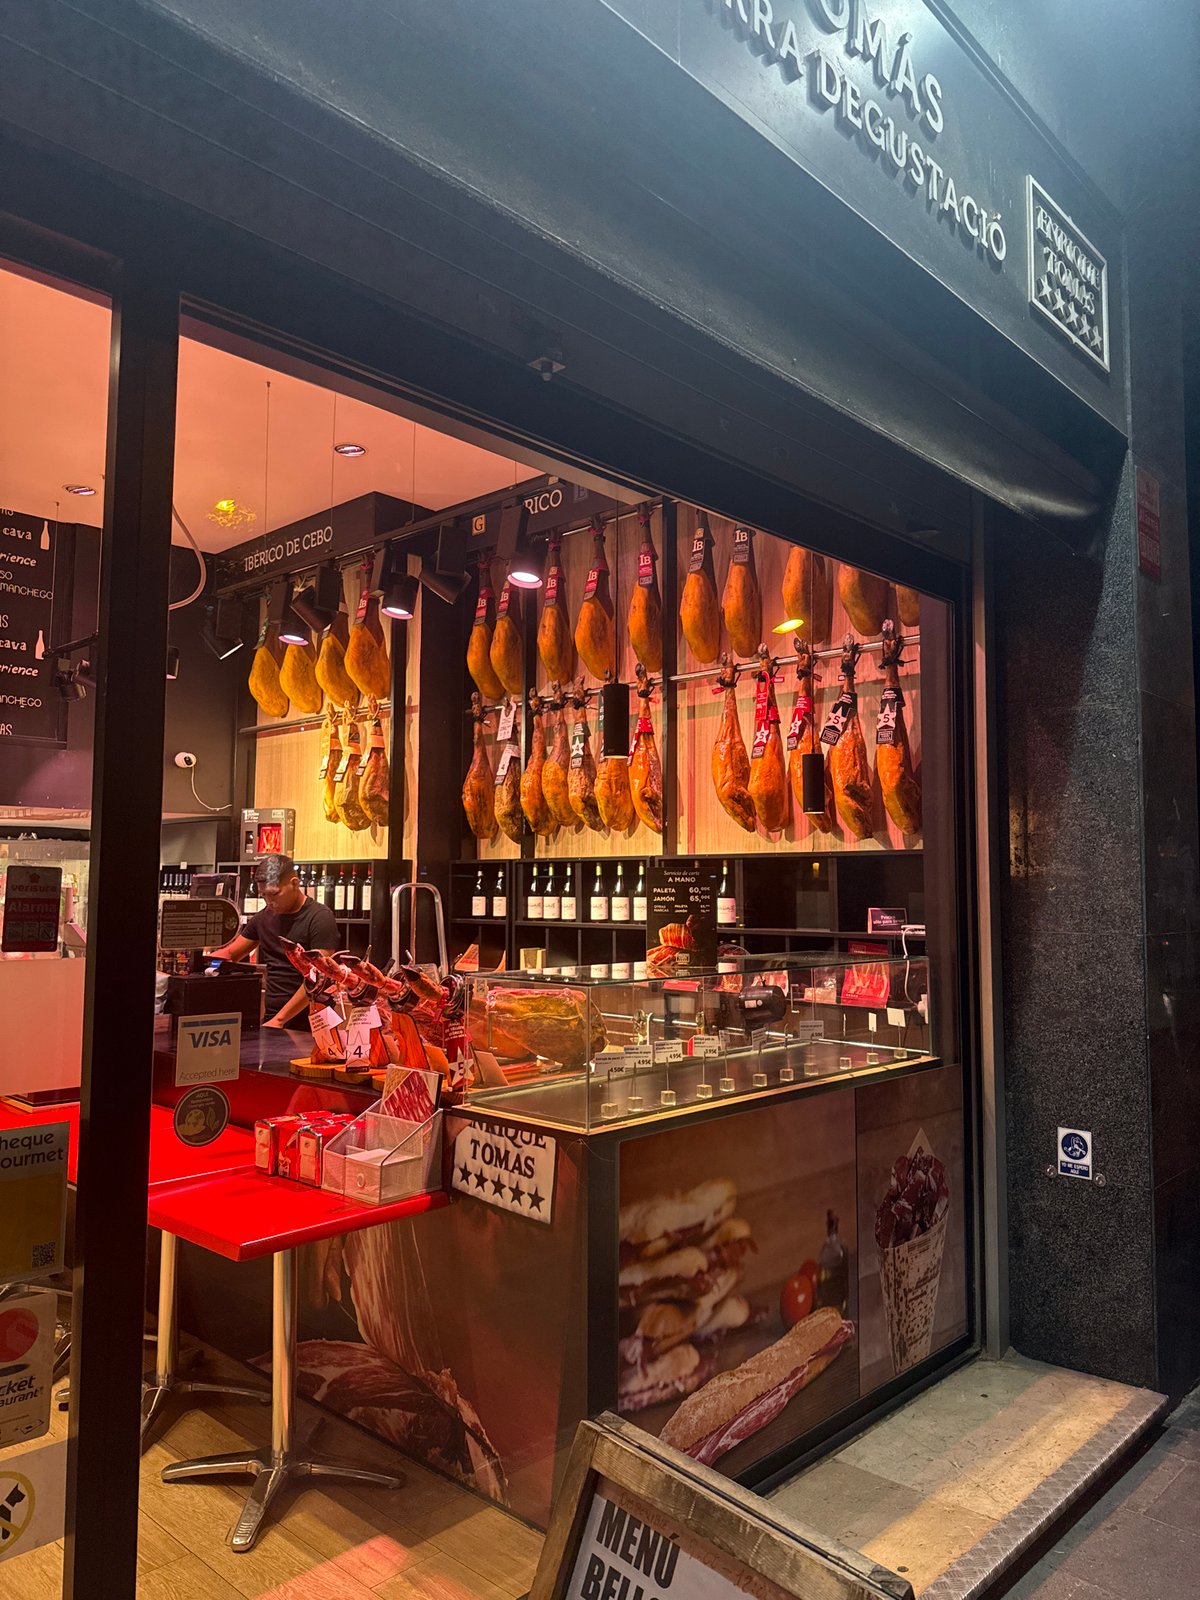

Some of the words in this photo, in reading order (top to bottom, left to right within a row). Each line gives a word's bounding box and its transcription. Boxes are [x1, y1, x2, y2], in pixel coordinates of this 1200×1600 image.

[815, 49, 1007, 261] DEGUSTACIÓ
[474, 517, 484, 531] G
[2, 527, 32, 541] cava
[286, 538, 301, 557] DE
[302, 525, 333, 550] CEBO
[735, 529, 748, 542] IB
[692, 539, 704, 552] IB
[639, 554, 652, 567] IB
[8, 901, 57, 913] Alarma
[186, 1029, 232, 1048] VISA
[353, 1045, 363, 1058] 4
[180, 1068, 217, 1080] Accepted
[219, 1066, 236, 1076] here
[0, 1147, 64, 1169] ourmet
[470, 1138, 535, 1179] TOMAS
[596, 1498, 681, 1589] MENÚ
